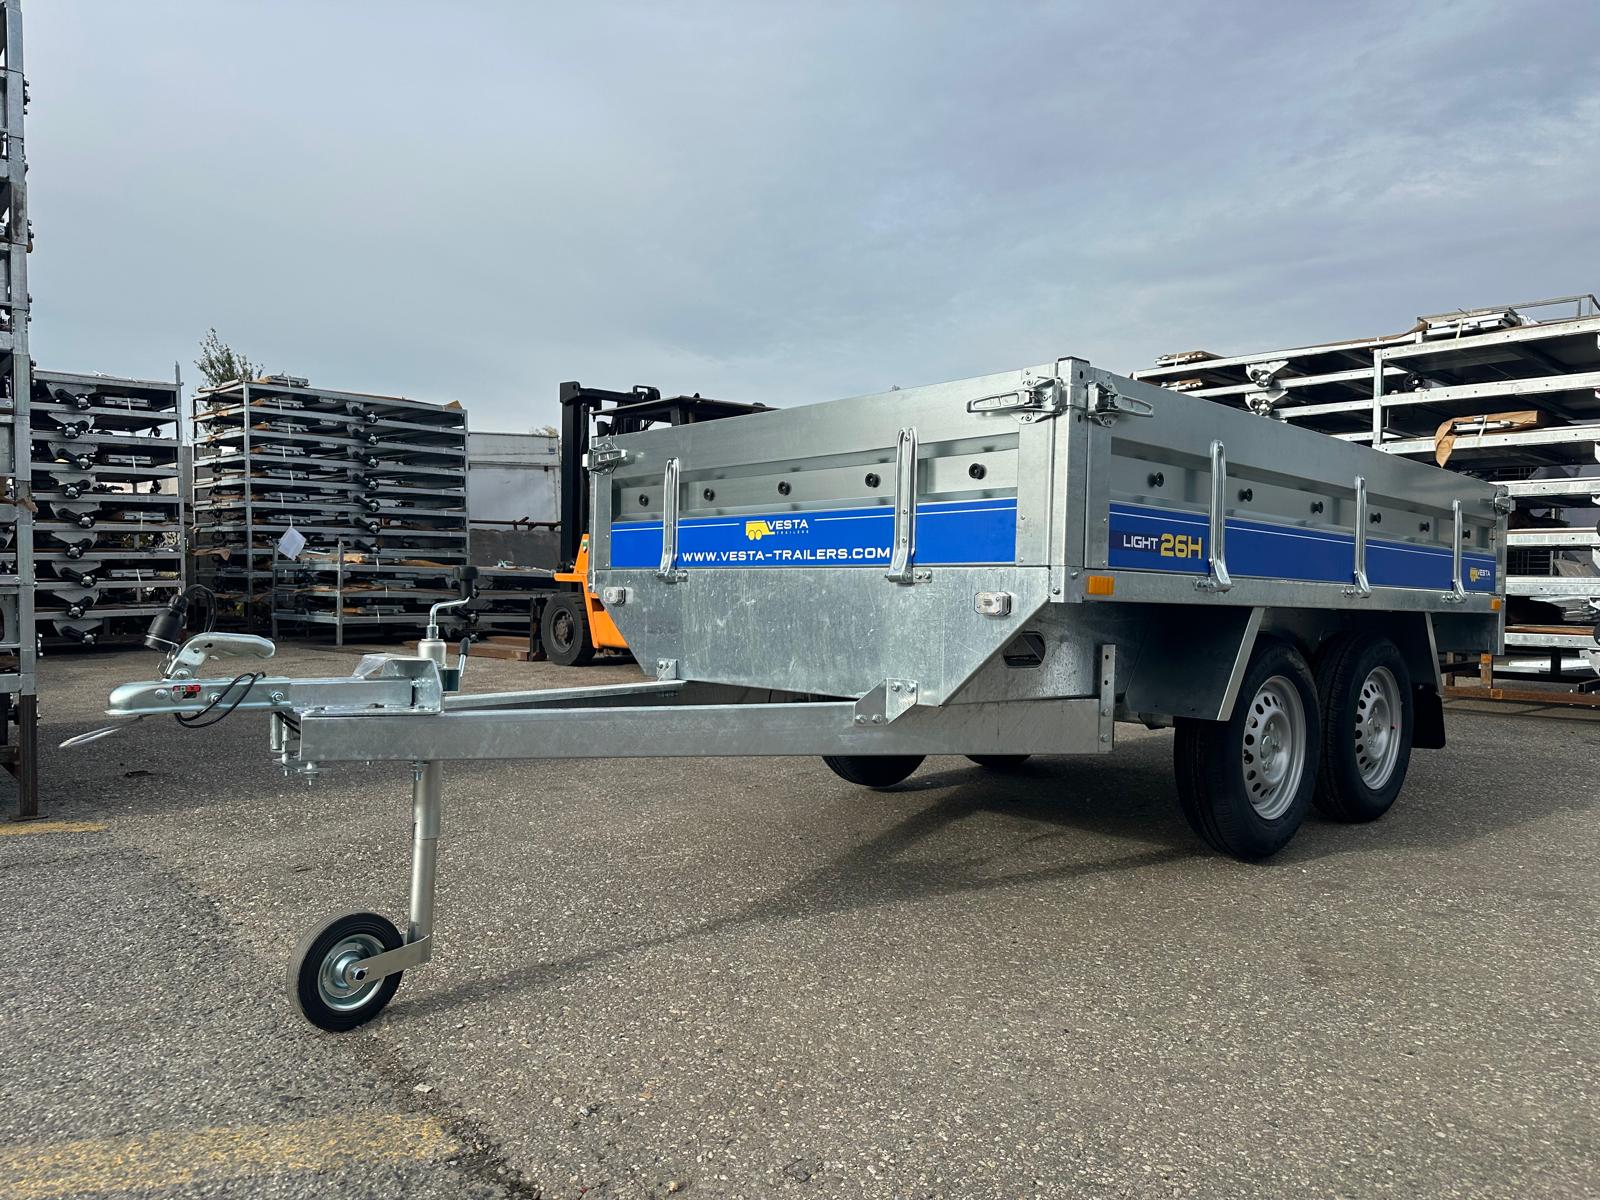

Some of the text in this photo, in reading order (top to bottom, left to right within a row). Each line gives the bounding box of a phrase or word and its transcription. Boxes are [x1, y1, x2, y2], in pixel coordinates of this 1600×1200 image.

[767, 519, 809, 530] VESTA
[1123, 533, 1202, 559] LIGHT 26H
[682, 547, 891, 562] WWW.VESTA-TRAILERS.COM
